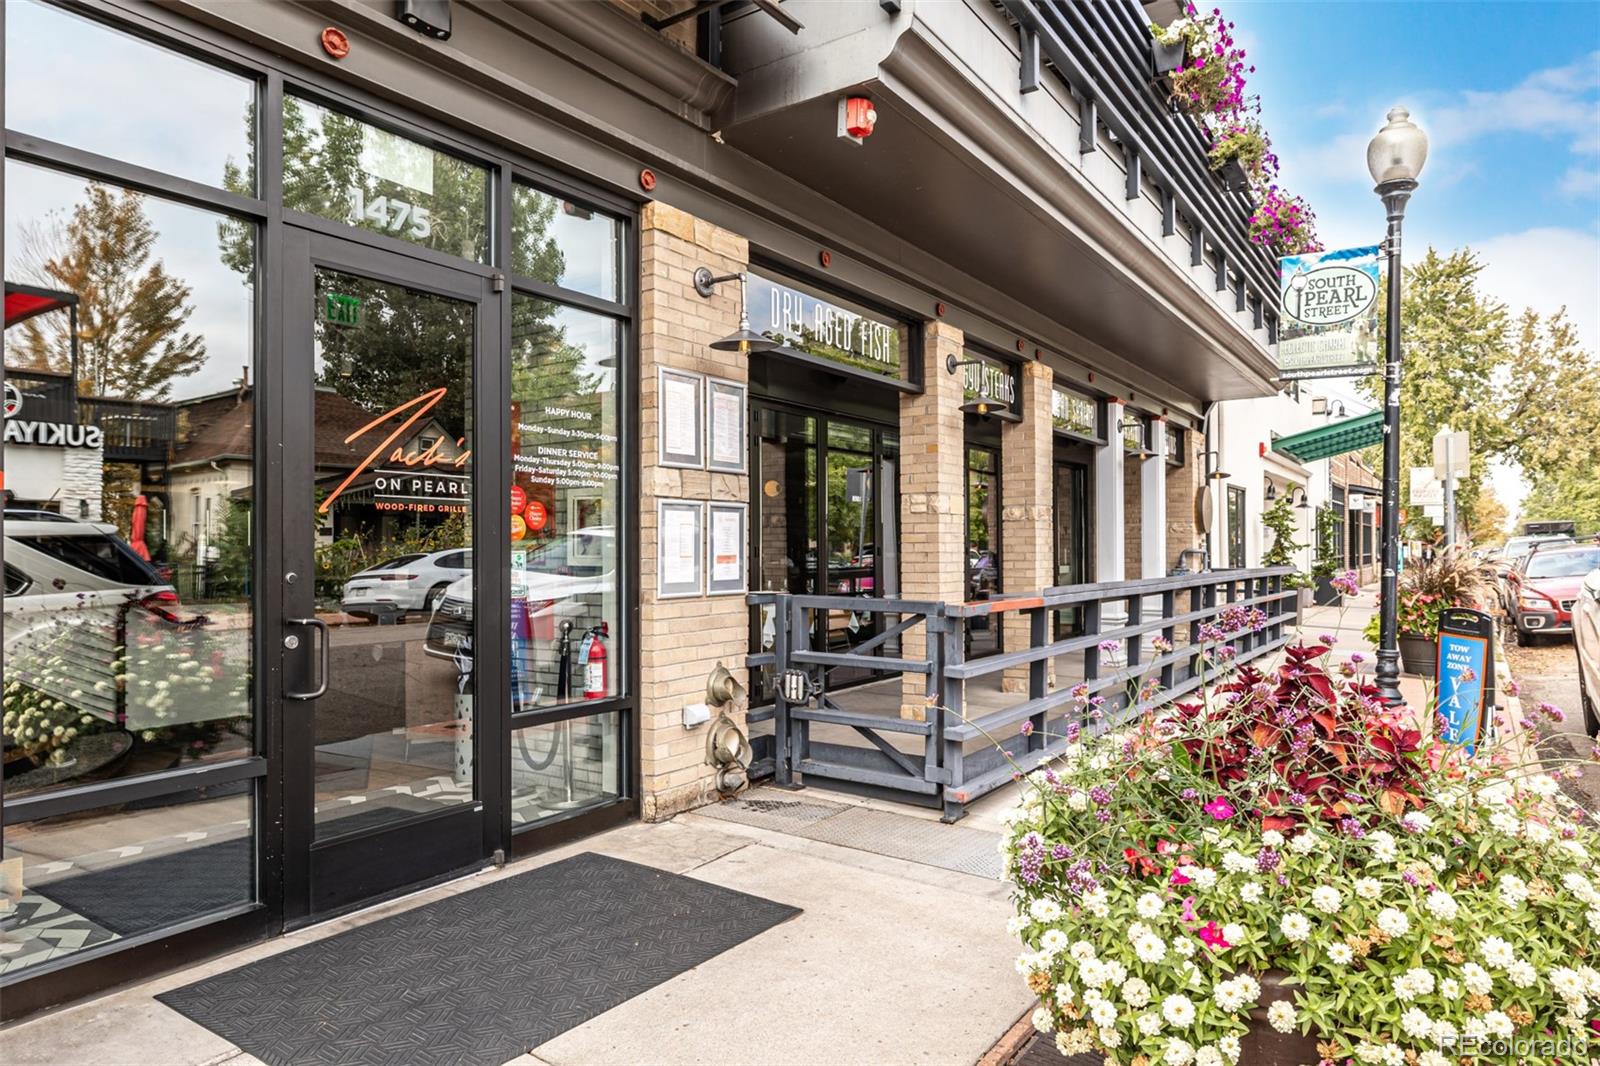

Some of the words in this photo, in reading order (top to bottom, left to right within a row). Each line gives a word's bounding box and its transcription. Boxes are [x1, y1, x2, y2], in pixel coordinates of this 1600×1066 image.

[346, 186, 431, 239] 1475
[1308, 275, 1356, 290] SOUTH
[1304, 286, 1368, 308] PEARL
[1304, 304, 1351, 319] STREET
[771, 287, 802, 335] DRY
[814, 303, 852, 351] AGED
[861, 321, 890, 363] FISH
[985, 367, 1015, 404] STEAKS
[545, 407, 570, 419] HAPPY
[571, 410, 592, 420] HOUR
[538, 446, 567, 457] DINNER
[568, 450, 598, 460] SERVICE
[513, 454, 571, 468] Monday-Thursday
[514, 465, 567, 477] Friday-Saturday
[375, 477, 401, 491] ON
[412, 480, 468, 494] PEARL
[531, 475, 555, 485] Sunday
[375, 502, 435, 512] WOOD-FIRED
[437, 504, 467, 513] GRILLE
[1449, 643, 1470, 653] TOW
[1447, 652, 1472, 663] AWAY
[1449, 676, 1462, 743] VALE
